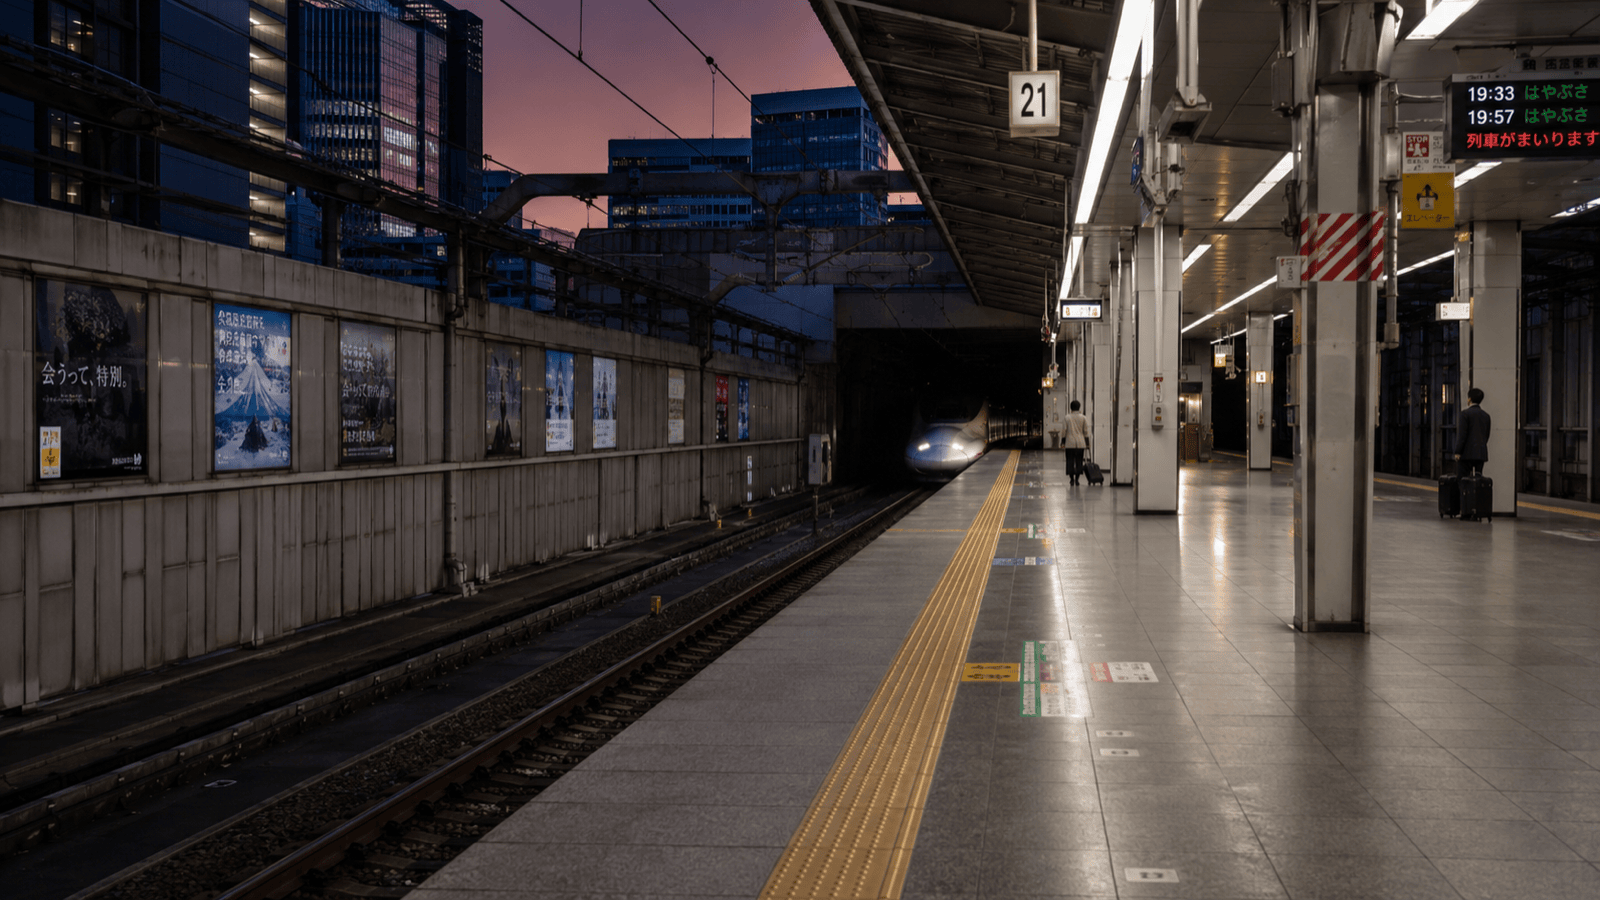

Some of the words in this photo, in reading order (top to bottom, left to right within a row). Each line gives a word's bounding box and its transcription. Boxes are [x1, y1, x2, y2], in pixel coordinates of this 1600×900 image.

[1020, 82, 1047, 118] 21
[1467, 85, 1516, 102] 19:33
[1524, 83, 1589, 100] はやぶさ
[1467, 109, 1516, 126] 19:57
[1524, 107, 1589, 124] はやぶさ
[1406, 135, 1429, 144] STOP
[1466, 130, 1600, 149] 列車がまいります
[41, 361, 128, 389] 会うって、特別。
